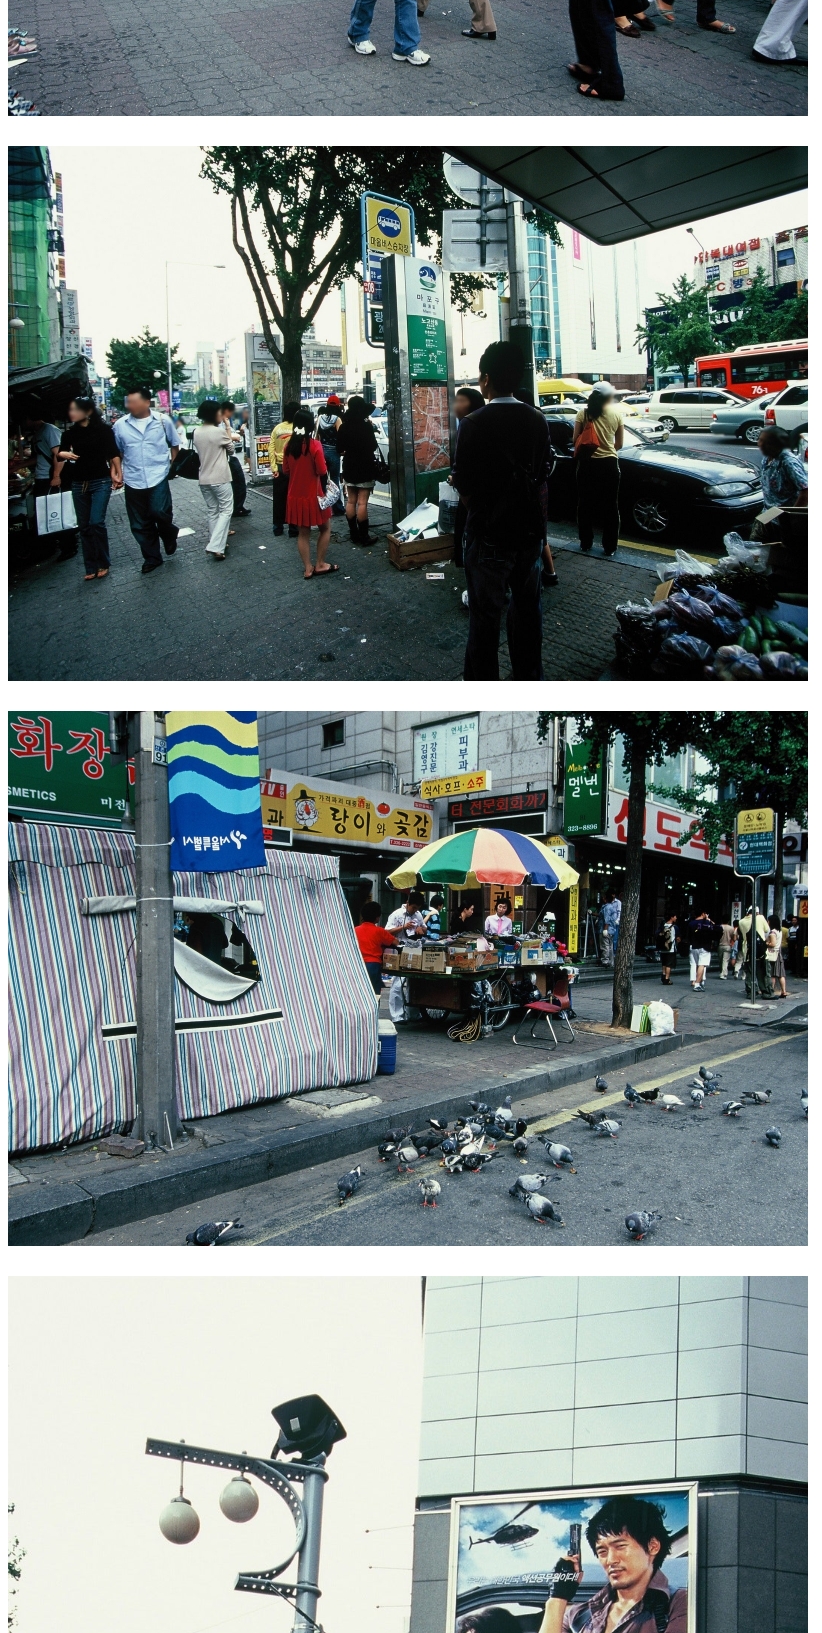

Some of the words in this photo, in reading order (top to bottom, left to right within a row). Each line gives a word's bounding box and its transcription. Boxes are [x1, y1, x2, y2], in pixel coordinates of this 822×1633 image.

[370, 236, 409, 254] 마을버스승차장
[416, 293, 440, 305] 마포구
[752, 385, 769, 395] 76-1
[450, 722, 476, 735] 연세스타
[420, 744, 429, 774] 김영구
[430, 742, 438, 773] 강진문
[458, 735, 469, 772] 피부과
[568, 774, 600, 798] 멜번
[452, 804, 463, 817] 터
[376, 822, 387, 836] 와
[394, 810, 429, 838] 곶감
[568, 824, 598, 832] 323-8896
